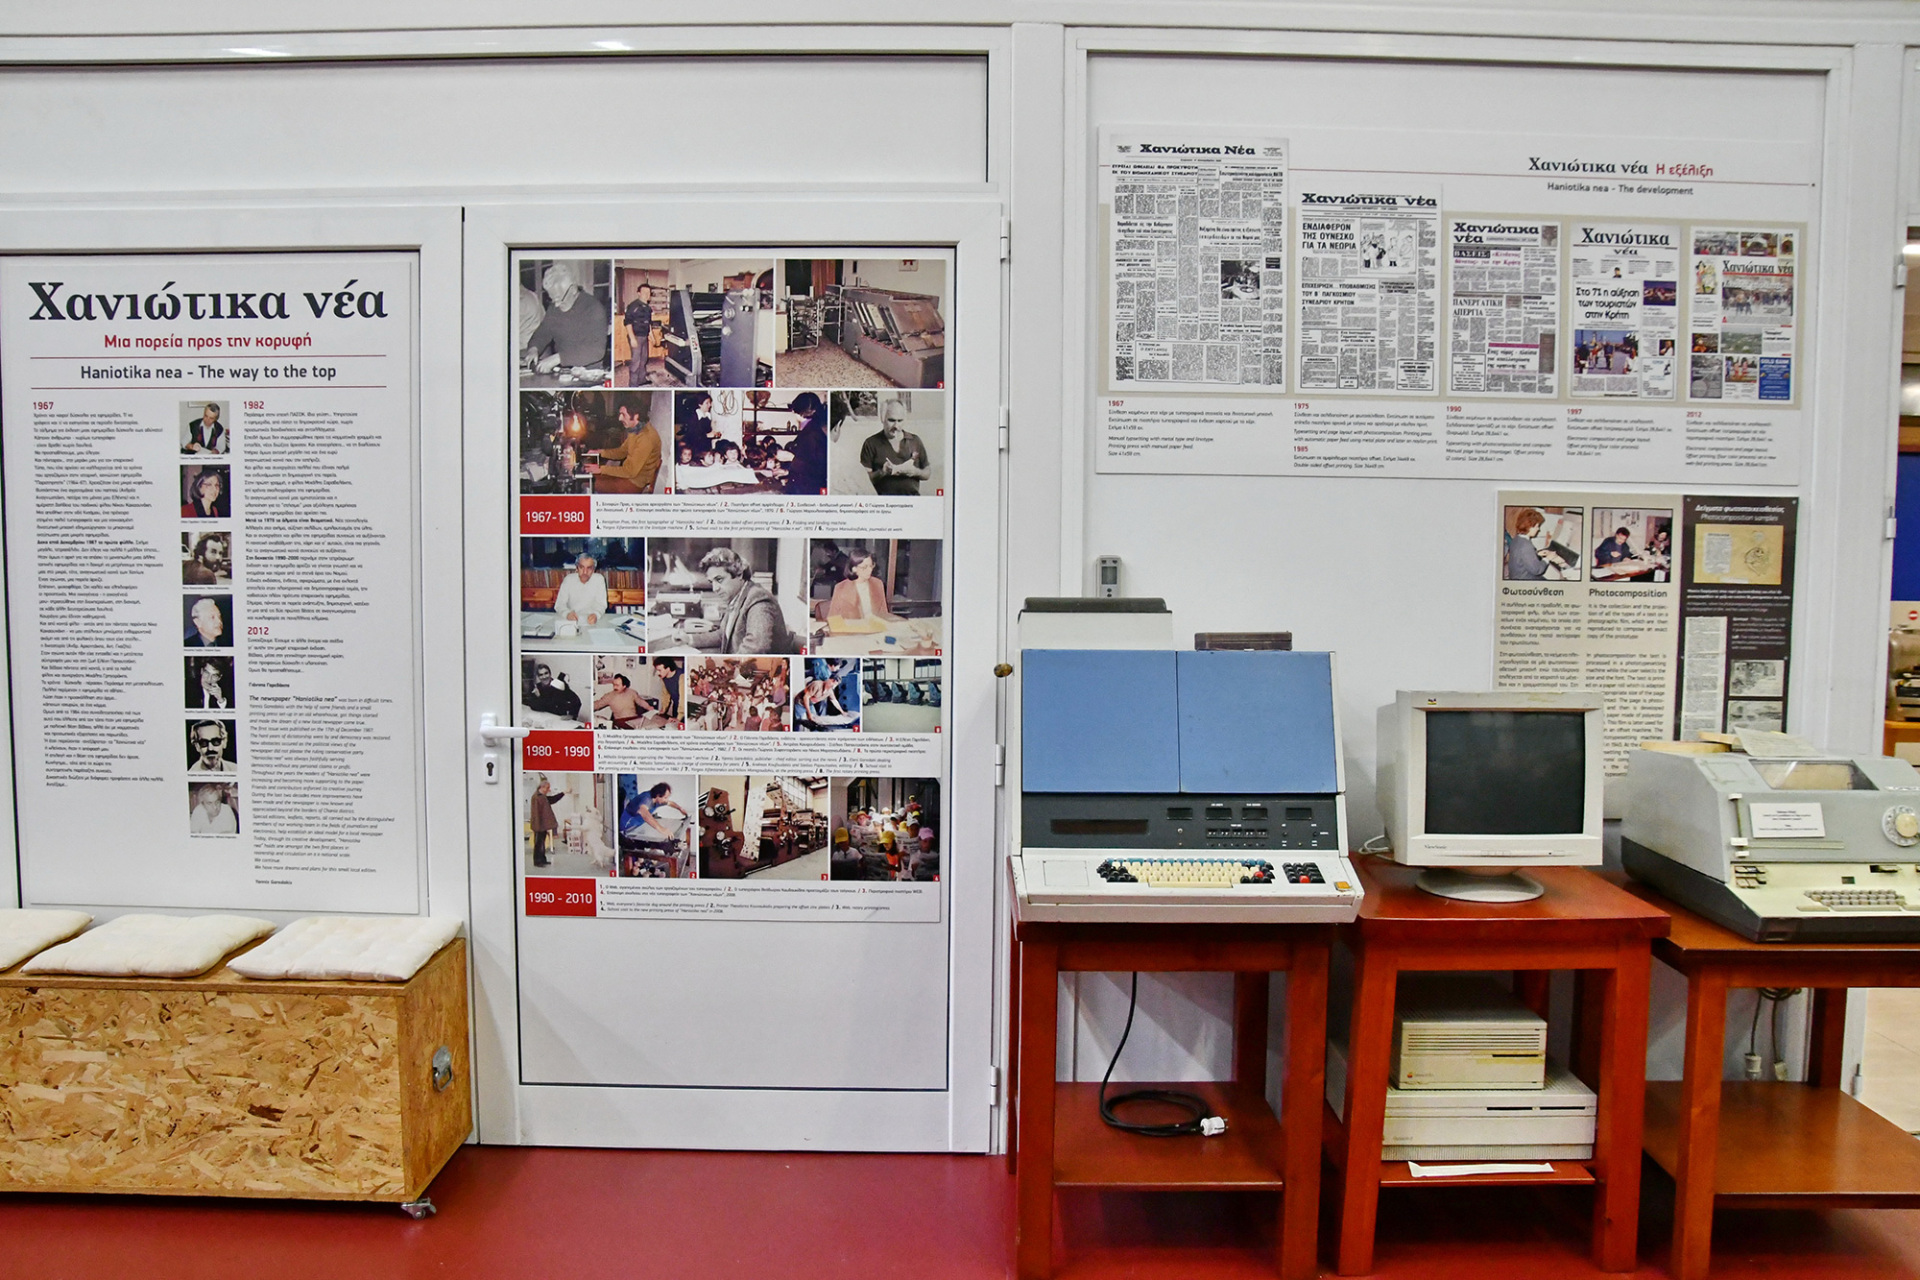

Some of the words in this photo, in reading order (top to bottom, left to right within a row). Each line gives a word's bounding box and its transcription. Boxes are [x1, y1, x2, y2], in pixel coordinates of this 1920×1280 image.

[1140, 144, 1221, 154] Χανιώτικα
[1224, 145, 1256, 155] Νέα
[1529, 157, 1616, 173] Χανιώτικα
[1621, 160, 1648, 174] νέα
[1656, 164, 1665, 174] Η
[1669, 163, 1714, 178] εξέλιξη
[1547, 182, 1590, 192] Haniotika
[1618, 184, 1634, 193] The
[1636, 185, 1694, 196] development
[1302, 193, 1397, 205] Χανιώτικα
[1404, 195, 1437, 207] νέα
[1302, 223, 1351, 231] ΕΝΔΙΑΦΕΡΟΝ
[1453, 222, 1540, 237] Χανιώτικα
[1320, 232, 1354, 240] ΟΥΝΕΣΚΟ
[1454, 233, 1484, 244] νέα
[1582, 228, 1670, 246] Χανιώτικα
[1330, 242, 1356, 250] ΝΕΩΡΙΑ
[1614, 246, 1638, 255] νέα
[1722, 260, 1775, 274] Χανιώτικα
[1777, 261, 1794, 275] νέα
[28, 281, 290, 321] Χανιώτικα
[303, 279, 388, 319] νέα
[1595, 299, 1637, 309] τουριστών
[1605, 310, 1629, 320] Κρήτη
[105, 335, 131, 348] Μια
[136, 334, 183, 351] πορεία
[188, 337, 223, 351] προς
[227, 337, 251, 347] την
[256, 332, 312, 350] κορυφή
[81, 365, 151, 379] Haniotika
[156, 369, 182, 378] nea
[198, 365, 225, 379] The
[229, 368, 259, 382] way
[264, 366, 278, 378] to
[283, 364, 308, 378] the
[312, 366, 336, 381] top
[33, 401, 54, 410] 1967
[244, 401, 264, 409] 1982
[526, 511, 584, 522] 1967-1980
[1502, 587, 1564, 596] Φωτοσύνθεση
[1589, 588, 1667, 598] Photocomposition
[247, 626, 269, 635] 2012
[526, 745, 552, 756] 1980
[564, 746, 590, 757] 1990
[529, 892, 554, 903] 1990
[566, 893, 592, 904] 2010
